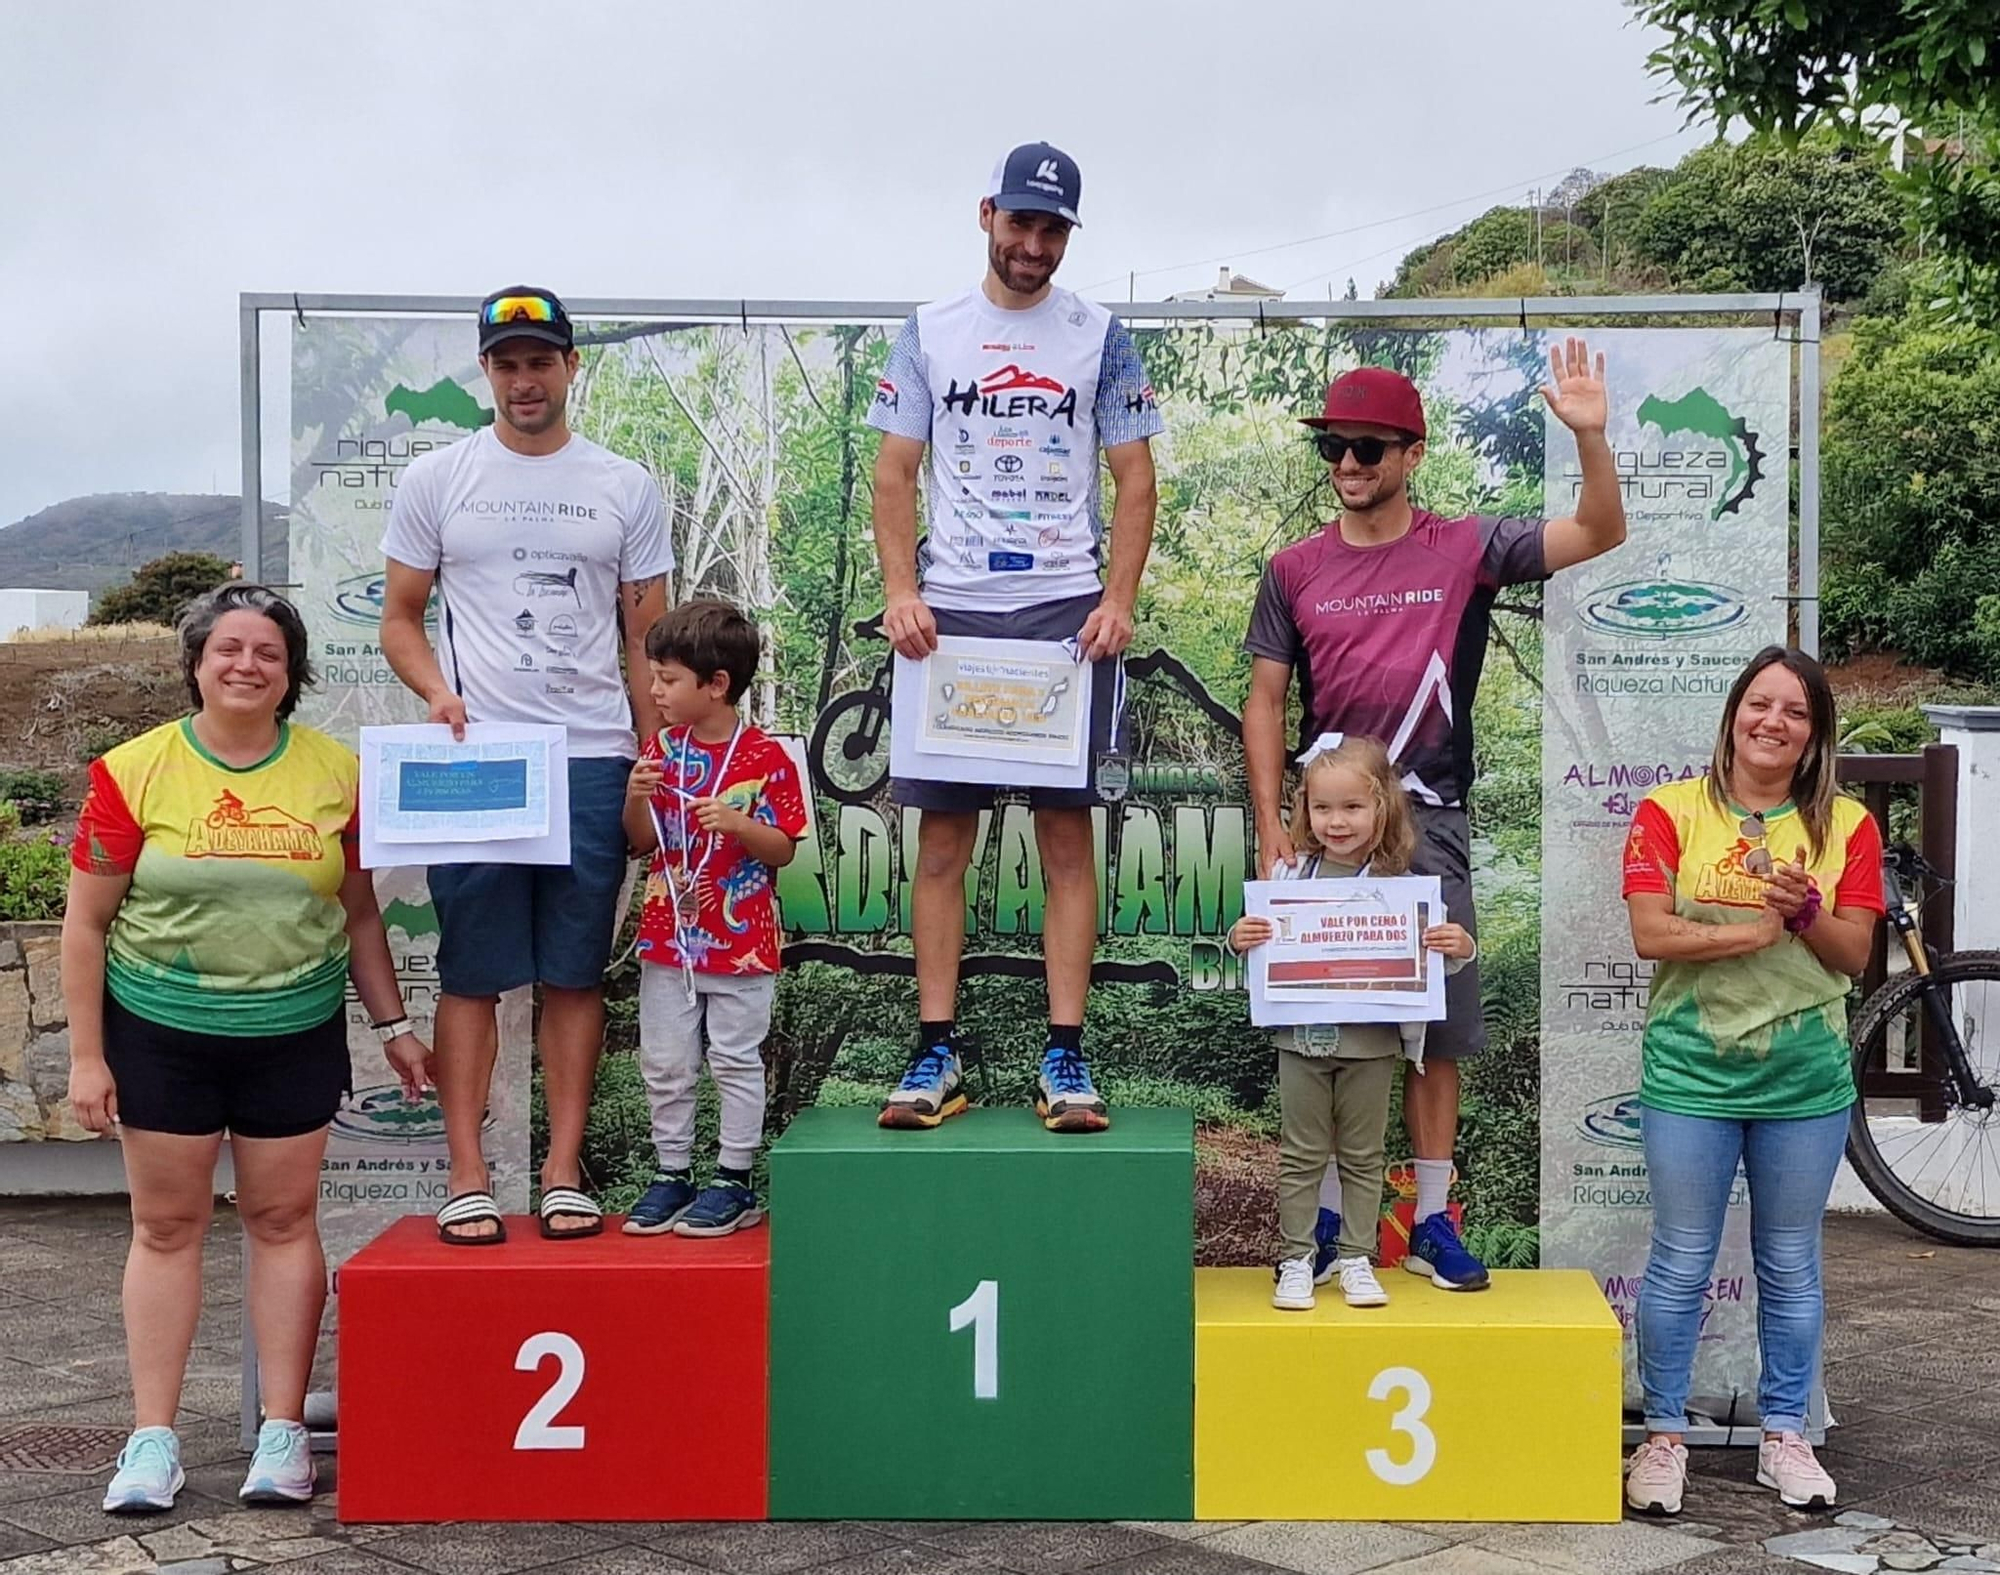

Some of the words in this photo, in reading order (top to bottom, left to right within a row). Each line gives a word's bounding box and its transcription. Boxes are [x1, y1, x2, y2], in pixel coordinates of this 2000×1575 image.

[942, 378, 1077, 428] HILERA
[337, 432, 452, 465] rique
[987, 436, 1032, 449] deporte
[1612, 442, 1727, 476] iqueza
[460, 500, 554, 515] MOUNTAIN
[558, 502, 598, 520] RIDE
[1636, 511, 1703, 522] Deportivo
[1315, 591, 1403, 616] MOUNTAIN
[1404, 588, 1444, 605] RIDE
[325, 643, 356, 656] San
[1576, 652, 1606, 666] San
[1612, 652, 1669, 666] Andrés
[1676, 656, 1685, 669] y
[1690, 653, 1750, 666] Sauces
[1672, 674, 1737, 694] Natur
[1130, 764, 1221, 794] AUCES
[185, 818, 323, 853] ADEYAHAMEN
[1321, 916, 1344, 928] VALE
[1347, 915, 1368, 927] POR
[1370, 914, 1396, 927] CENA
[1300, 930, 1354, 944] ALMUERZO
[1356, 931, 1384, 942] PARA
[1386, 930, 1407, 942] DOS
[319, 1159, 350, 1171] San
[356, 1158, 415, 1171] Andrés
[420, 1161, 430, 1173] y
[1573, 1164, 1603, 1177] San
[1609, 1164, 1647, 1177] Andr
[949, 1280, 998, 1400] 1
[513, 1331, 586, 1451] 2
[1365, 1366, 1437, 1486] 3
